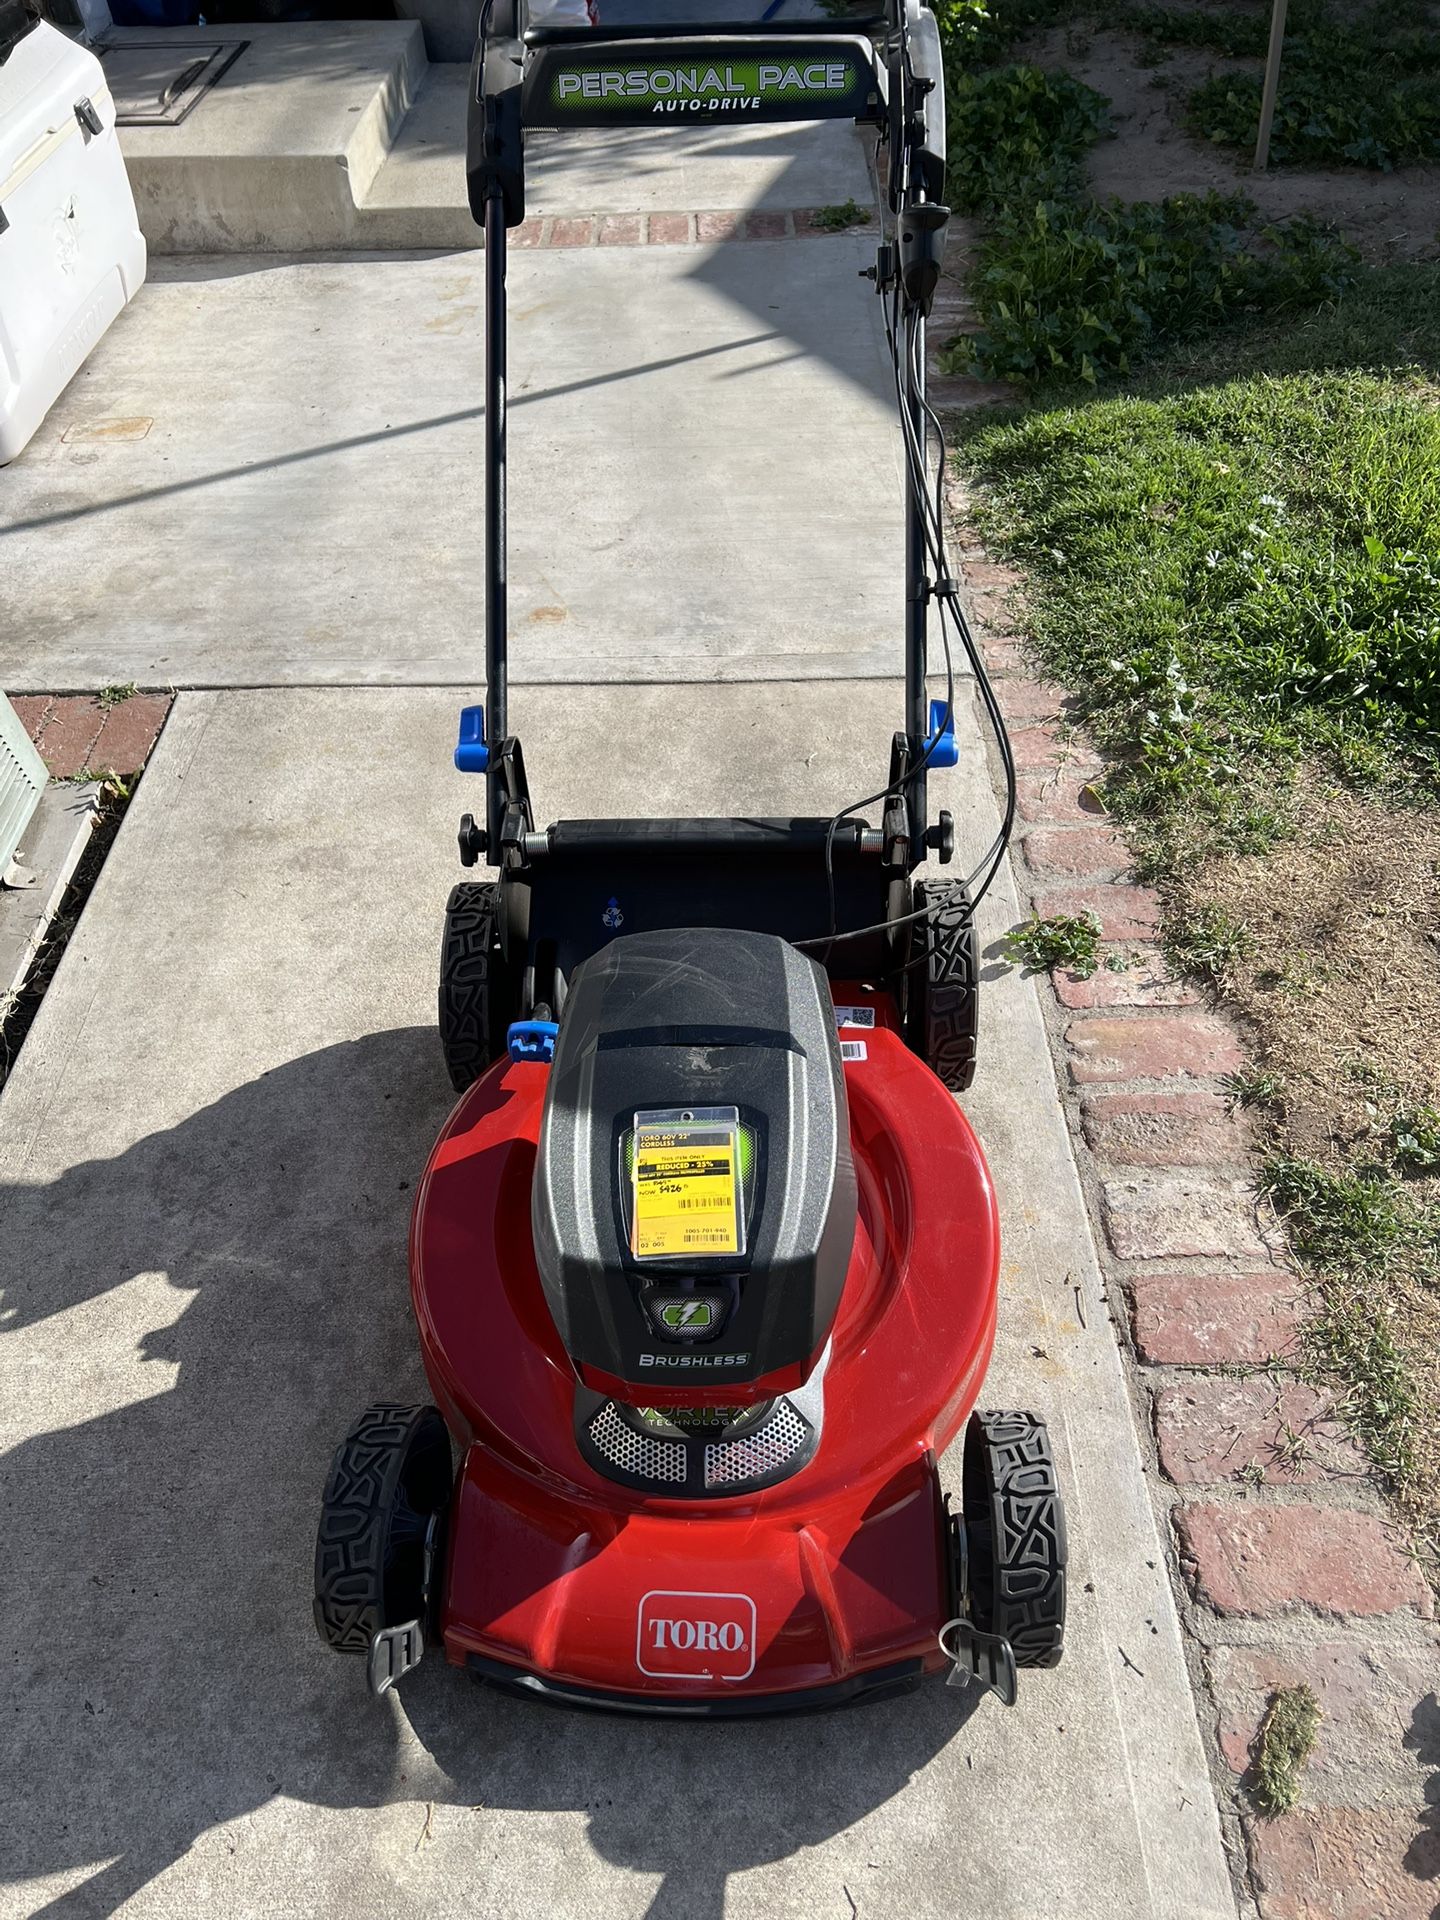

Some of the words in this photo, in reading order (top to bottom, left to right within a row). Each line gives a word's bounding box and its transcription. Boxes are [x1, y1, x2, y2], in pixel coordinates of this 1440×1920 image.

[558, 67, 744, 98] PERSONAL
[759, 63, 846, 90] PACE
[653, 96, 761, 112] AUTO-DRIVE
[641, 1134, 660, 1142] TORO
[662, 1133, 677, 1141] 60V
[641, 1140, 675, 1148] CORDLESS
[656, 1162, 690, 1171] REDUCED
[639, 1354, 748, 1367] BRUSHLESS
[649, 1418, 740, 1427] TECHNOLOGY
[649, 1619, 744, 1651] TORO
